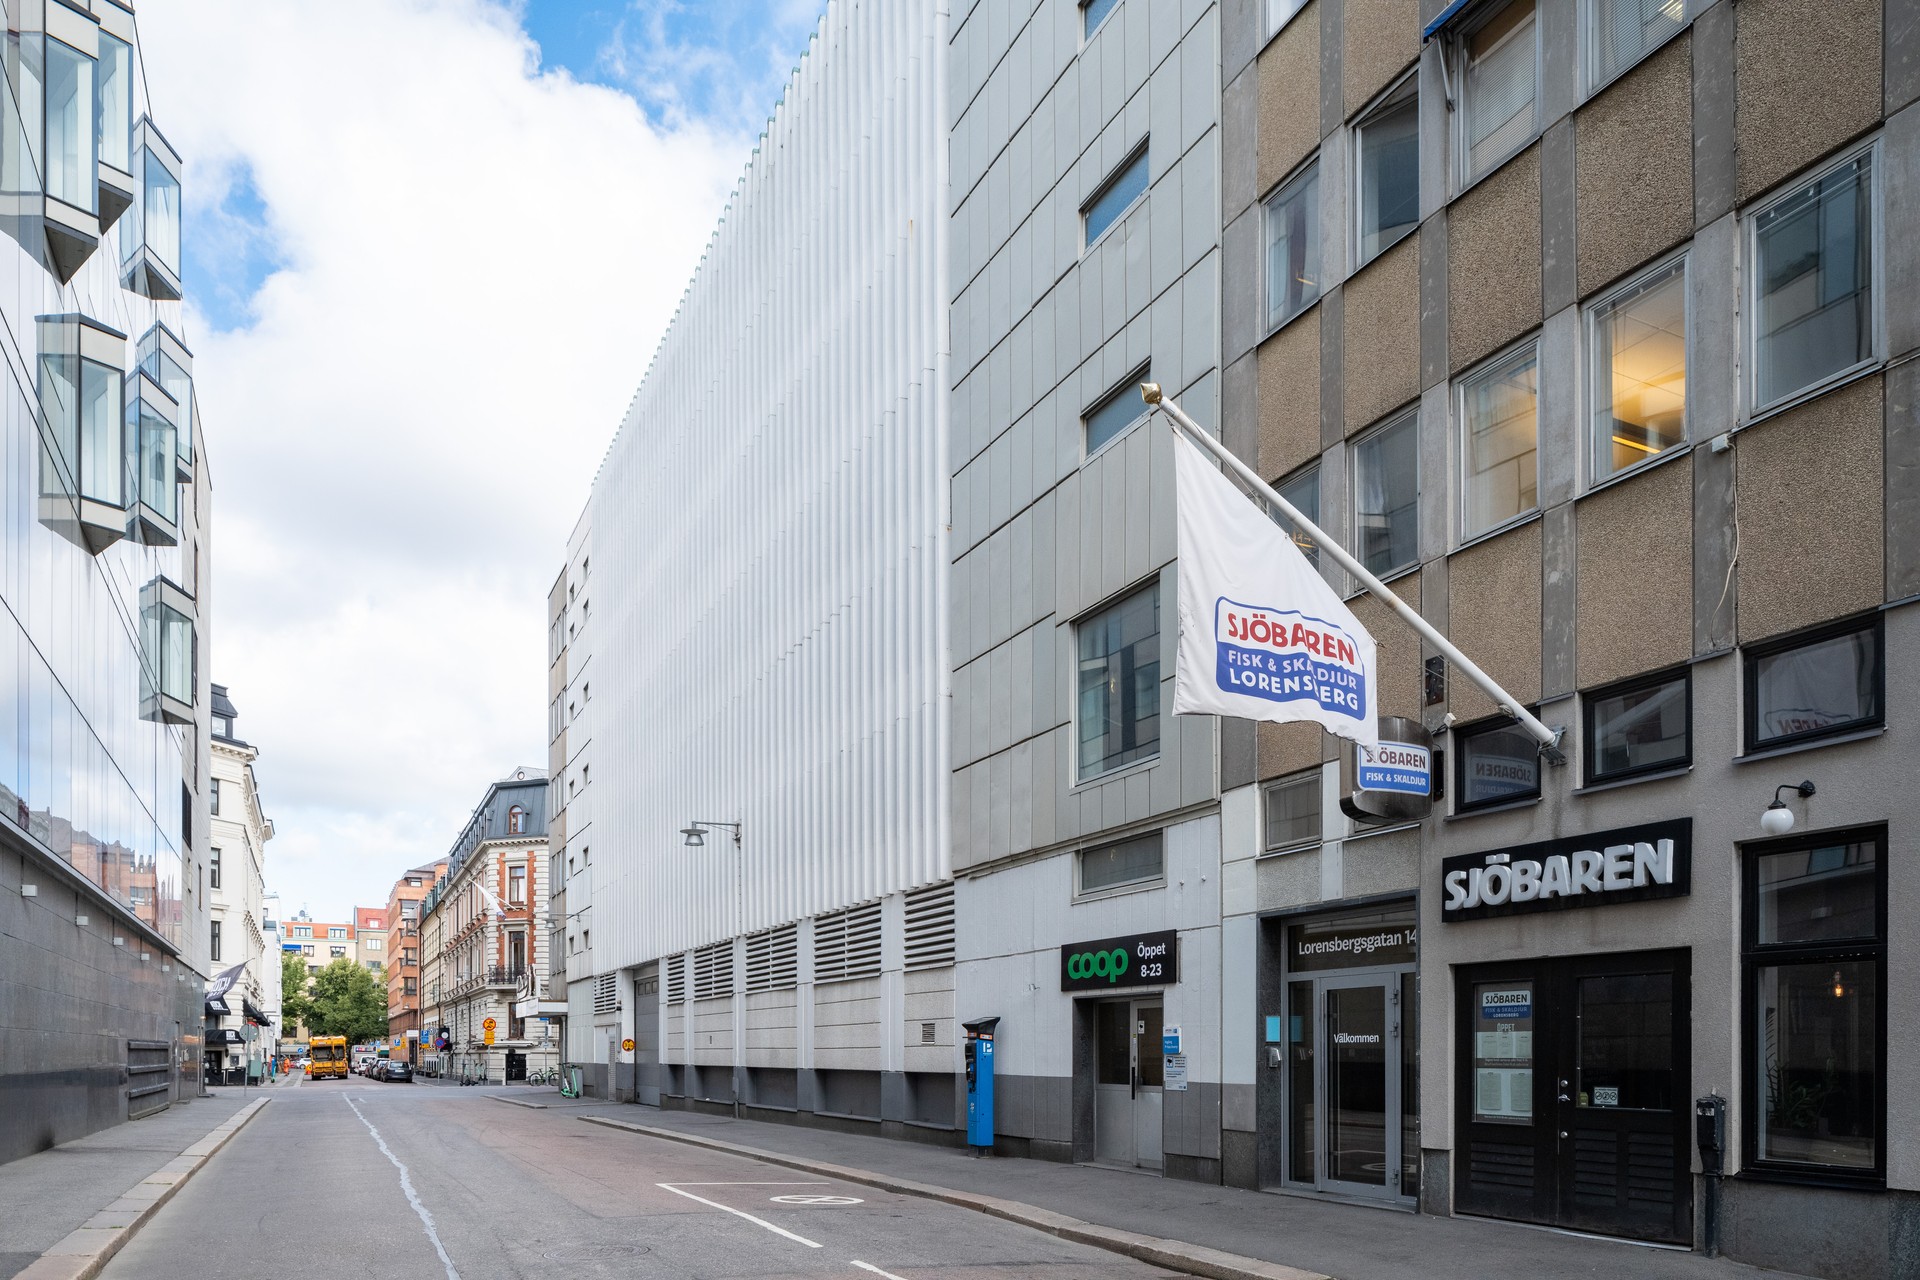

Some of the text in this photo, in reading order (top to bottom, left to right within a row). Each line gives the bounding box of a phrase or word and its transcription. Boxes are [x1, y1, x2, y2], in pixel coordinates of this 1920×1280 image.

[1228, 613, 1355, 665] SJÖBAREN
[1228, 650, 1263, 668] FISK
[1268, 658, 1277, 672] &
[1366, 747, 1426, 769] SÖBAREN
[1366, 772, 1426, 786] FISK & SKALDJUR
[1444, 838, 1674, 910] SJÖBAREN
[1137, 942, 1166, 959] Öppet
[1298, 929, 1417, 955] Lorensbergsgatan 14
[1067, 948, 1129, 983] coop
[1140, 963, 1162, 978] 8-23
[1485, 993, 1527, 1004] SJÖBAREN
[1497, 1023, 1515, 1032] ÖPPET
[1333, 1033, 1379, 1043] Välkommen
